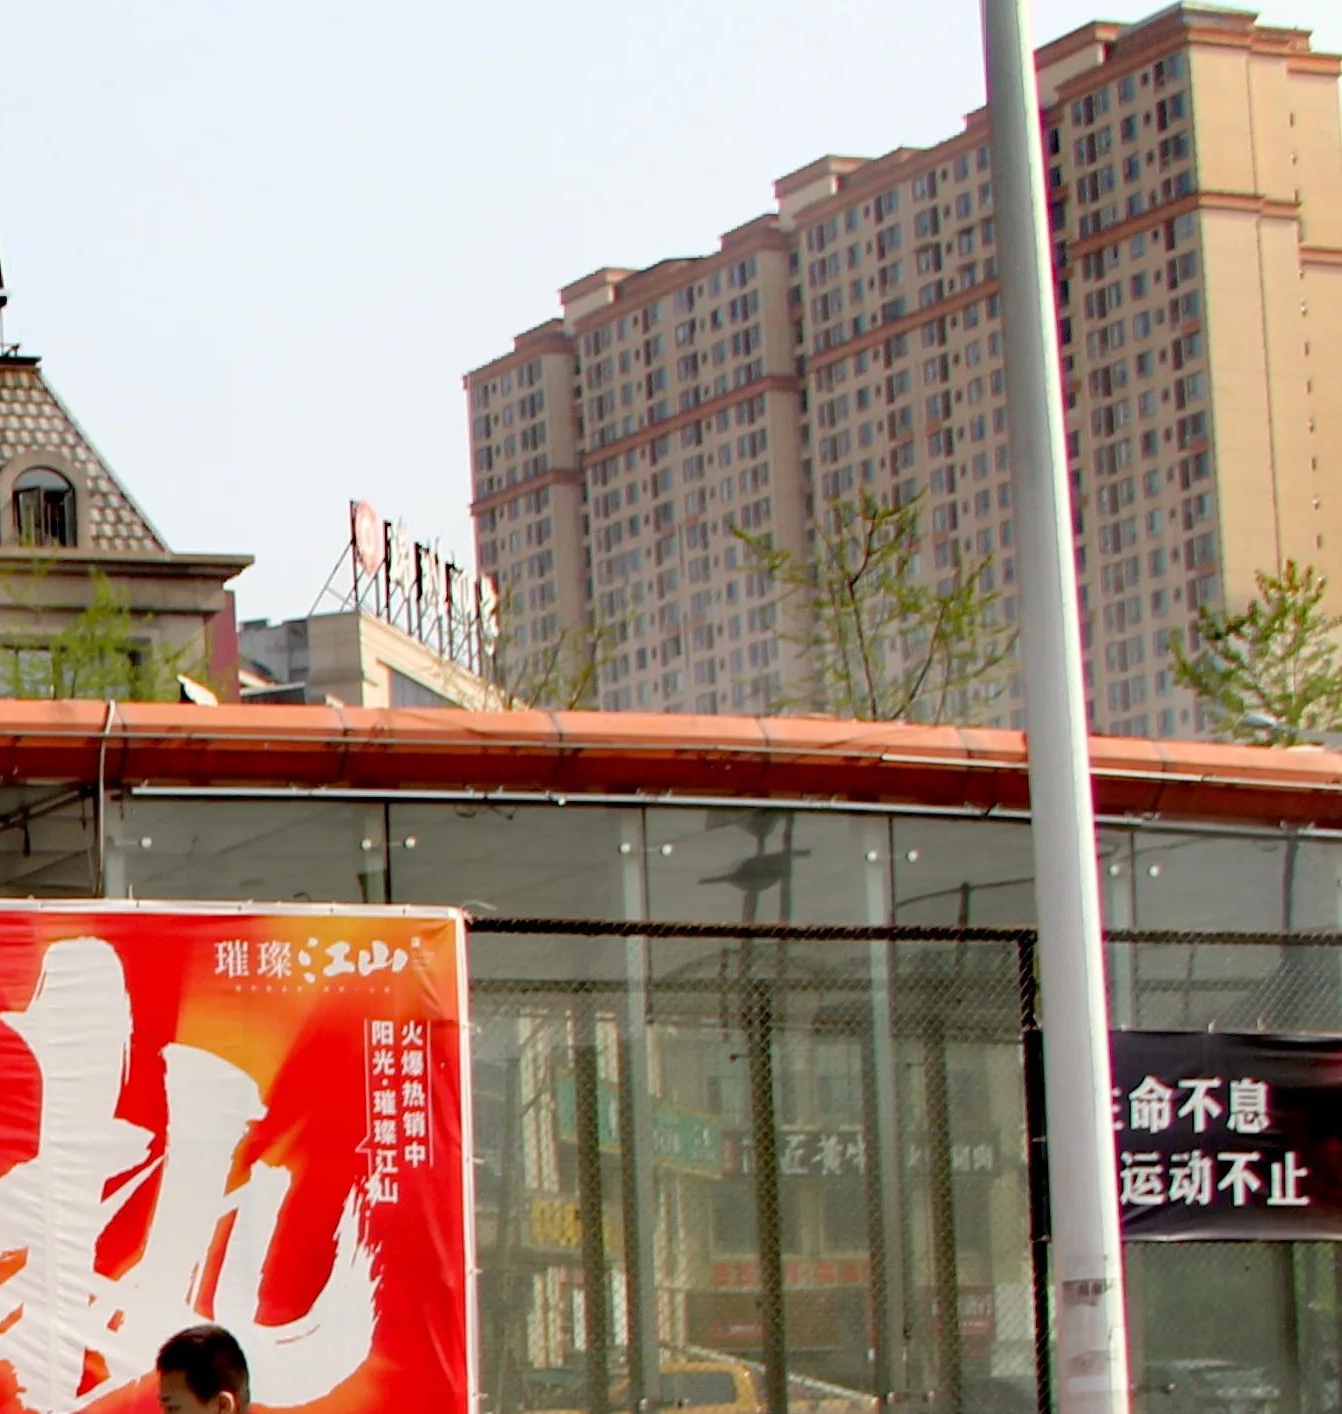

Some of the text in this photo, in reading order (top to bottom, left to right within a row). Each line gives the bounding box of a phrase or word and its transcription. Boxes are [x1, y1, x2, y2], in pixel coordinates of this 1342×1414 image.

[401, 1020, 425, 1168] 火爆热销中
[1120, 1152, 1310, 1206] 运动不止
